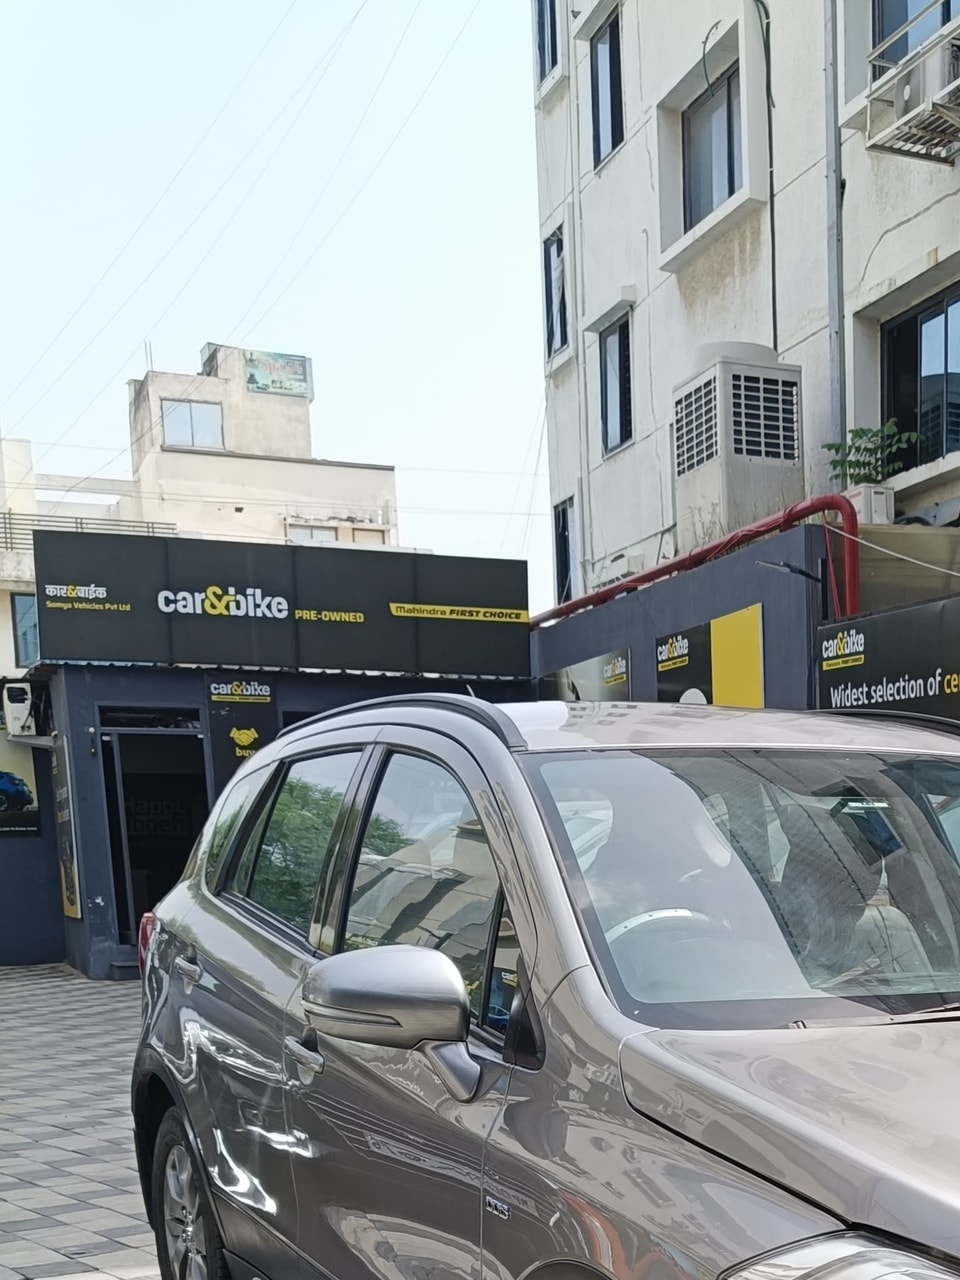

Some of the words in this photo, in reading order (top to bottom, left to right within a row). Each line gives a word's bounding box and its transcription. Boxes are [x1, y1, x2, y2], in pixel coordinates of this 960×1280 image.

[73, 602, 104, 610] Vehicles
[105, 603, 118, 611] Pvt
[157, 586, 289, 619] car&bike
[295, 610, 364, 622] PRE-OWNED
[396, 606, 447, 616] Mahindra
[449, 609, 482, 618] FIRST
[483, 611, 522, 620] CHOICE
[657, 635, 689, 661] car&bike
[822, 629, 864, 658] car&bike
[210, 681, 271, 695] car&bike
[830, 682, 868, 708] Widest
[870, 674, 924, 703] selection
[927, 668, 942, 696] of
